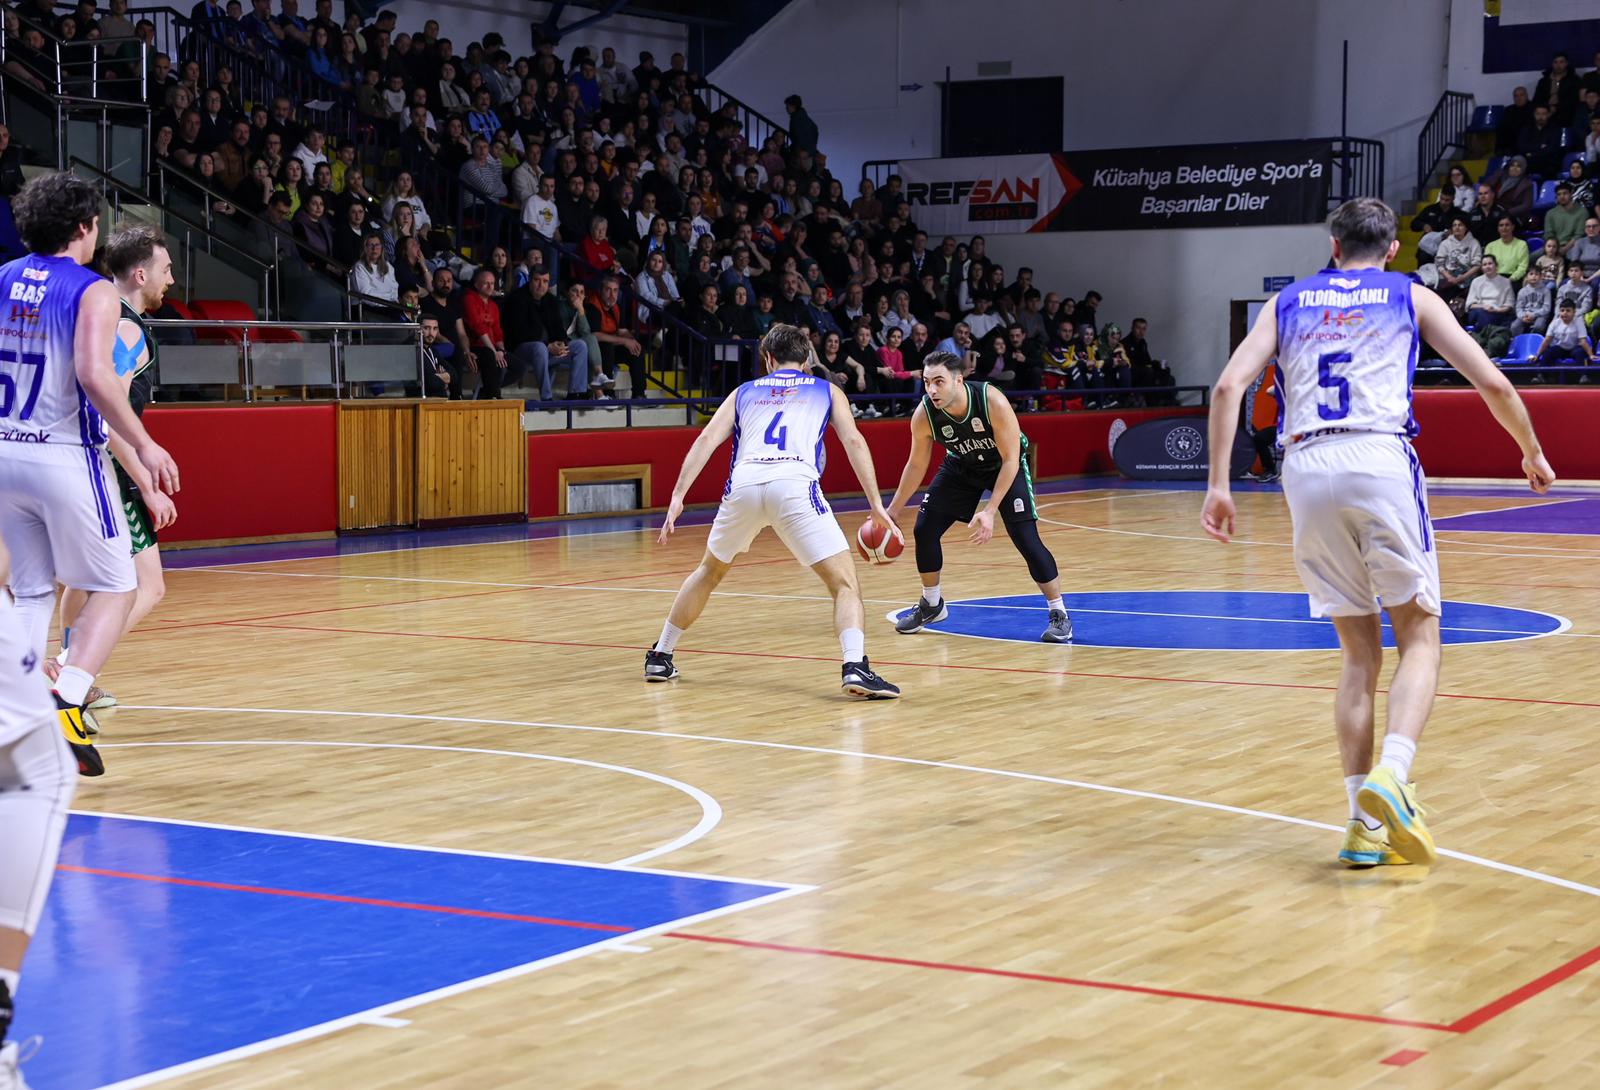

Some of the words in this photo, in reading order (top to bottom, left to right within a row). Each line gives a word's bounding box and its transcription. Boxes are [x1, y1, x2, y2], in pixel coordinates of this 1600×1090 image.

[907, 176, 1040, 206] REFSAN
[1092, 168, 1171, 190] Kütahya
[1176, 164, 1256, 187] Belediye
[1140, 197, 1221, 219] Başarılar
[1224, 193, 1269, 212] Diler
[1317, 352, 1352, 421] 5
[763, 411, 787, 451] 4
